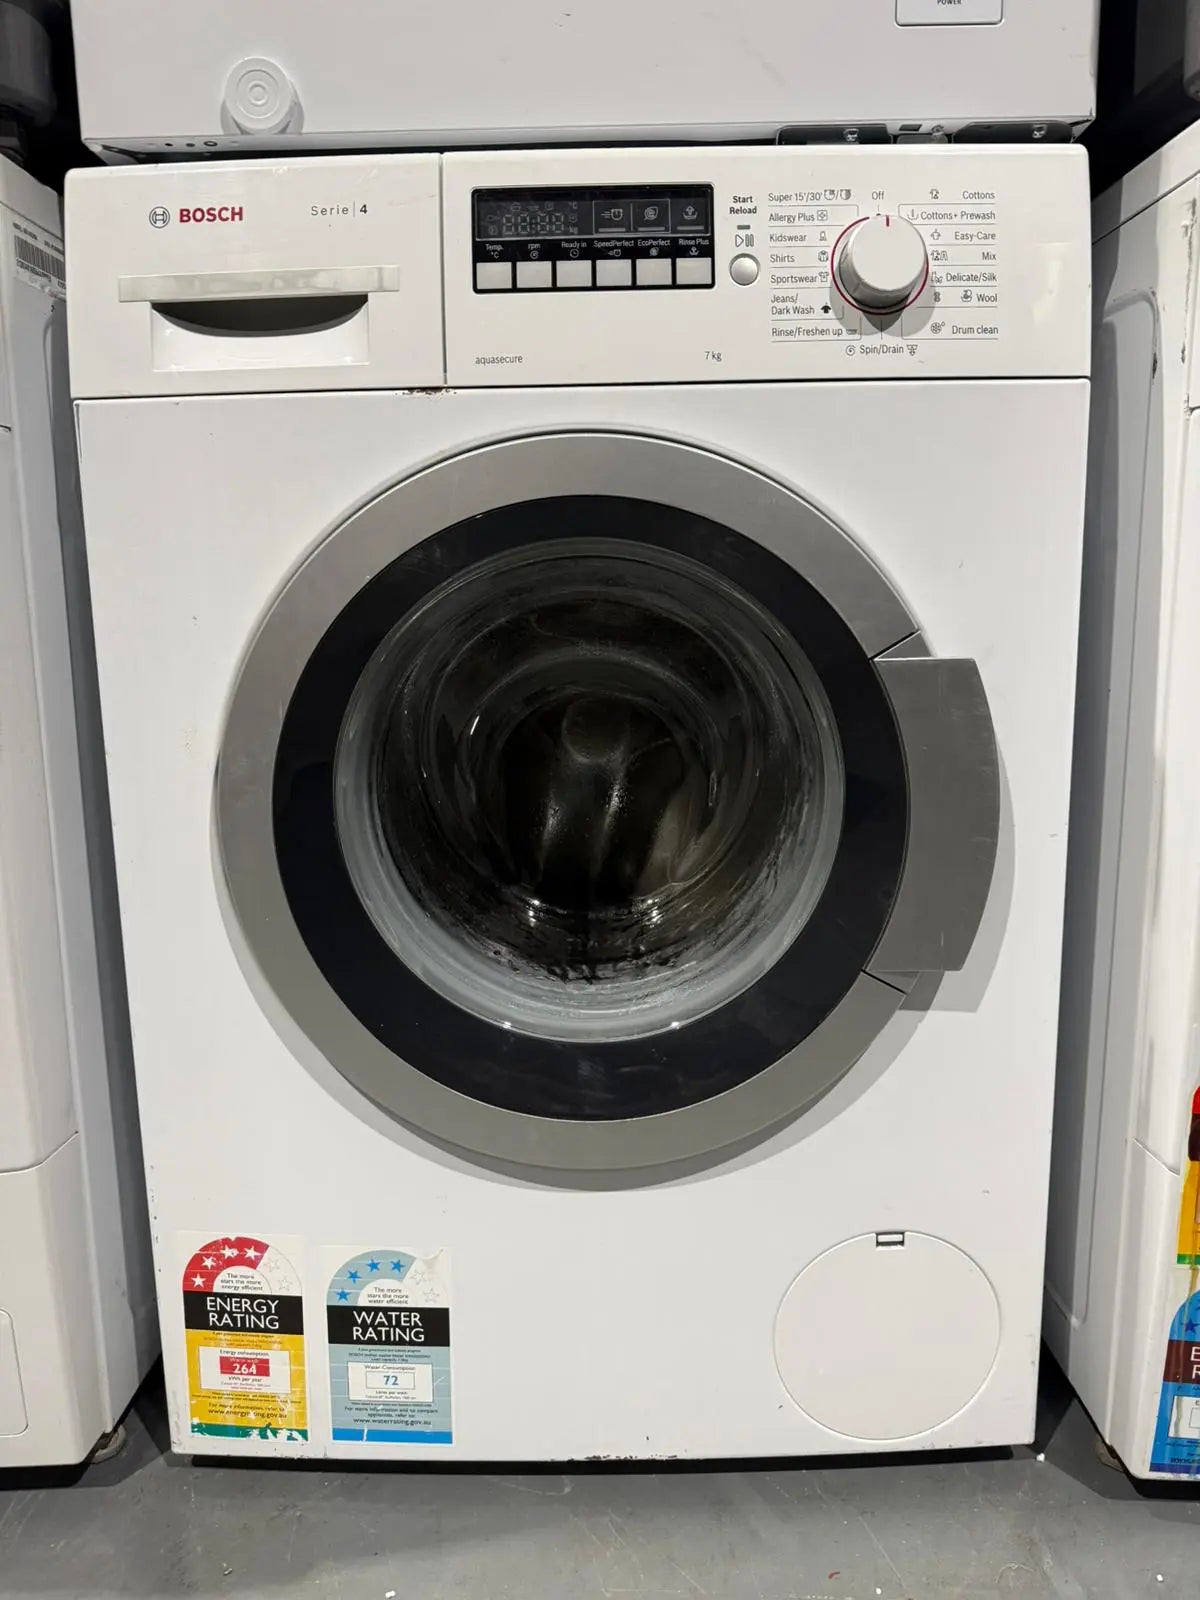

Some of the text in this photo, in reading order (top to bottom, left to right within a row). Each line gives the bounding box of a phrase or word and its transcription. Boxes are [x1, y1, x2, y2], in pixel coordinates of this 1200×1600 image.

[732, 195, 753, 204] Start
[768, 192, 793, 203] Super
[871, 190, 885, 200] Off
[962, 190, 996, 200] Cottons
[179, 206, 244, 223] BOSCH
[311, 204, 368, 216] Serie 4
[729, 206, 758, 215] Reload
[960, 210, 996, 220] Prewash
[768, 213, 815, 224] Allergy Plus
[678, 238, 710, 246] Rinse Plus
[769, 233, 807, 242] Kidswear
[954, 231, 996, 242] Easy-Care
[561, 240, 587, 249] Ready in
[593, 239, 635, 249] SpeedPerfect
[637, 238, 671, 247] EcoPerfect
[770, 254, 796, 264] Shirts
[981, 251, 997, 261] Mix
[770, 274, 818, 285] Sportswear
[945, 272, 997, 283] Delicate/Silk
[770, 293, 798, 304] Jeans/
[976, 293, 998, 303] Wool
[771, 305, 815, 315] Dark Wash
[771, 327, 843, 338] Rinse/Freshen up
[951, 324, 999, 335] Drum clean
[859, 344, 904, 356] Spin/Drain
[475, 354, 523, 366] aquasecure
[704, 350, 722, 362] 7 kg
[206, 1296, 279, 1314] ENERGY
[208, 1312, 280, 1329] RATING
[353, 1310, 423, 1327] WATER
[353, 1326, 425, 1342] RATING
[232, 1363, 257, 1374] 264
[383, 1375, 399, 1386] 72
